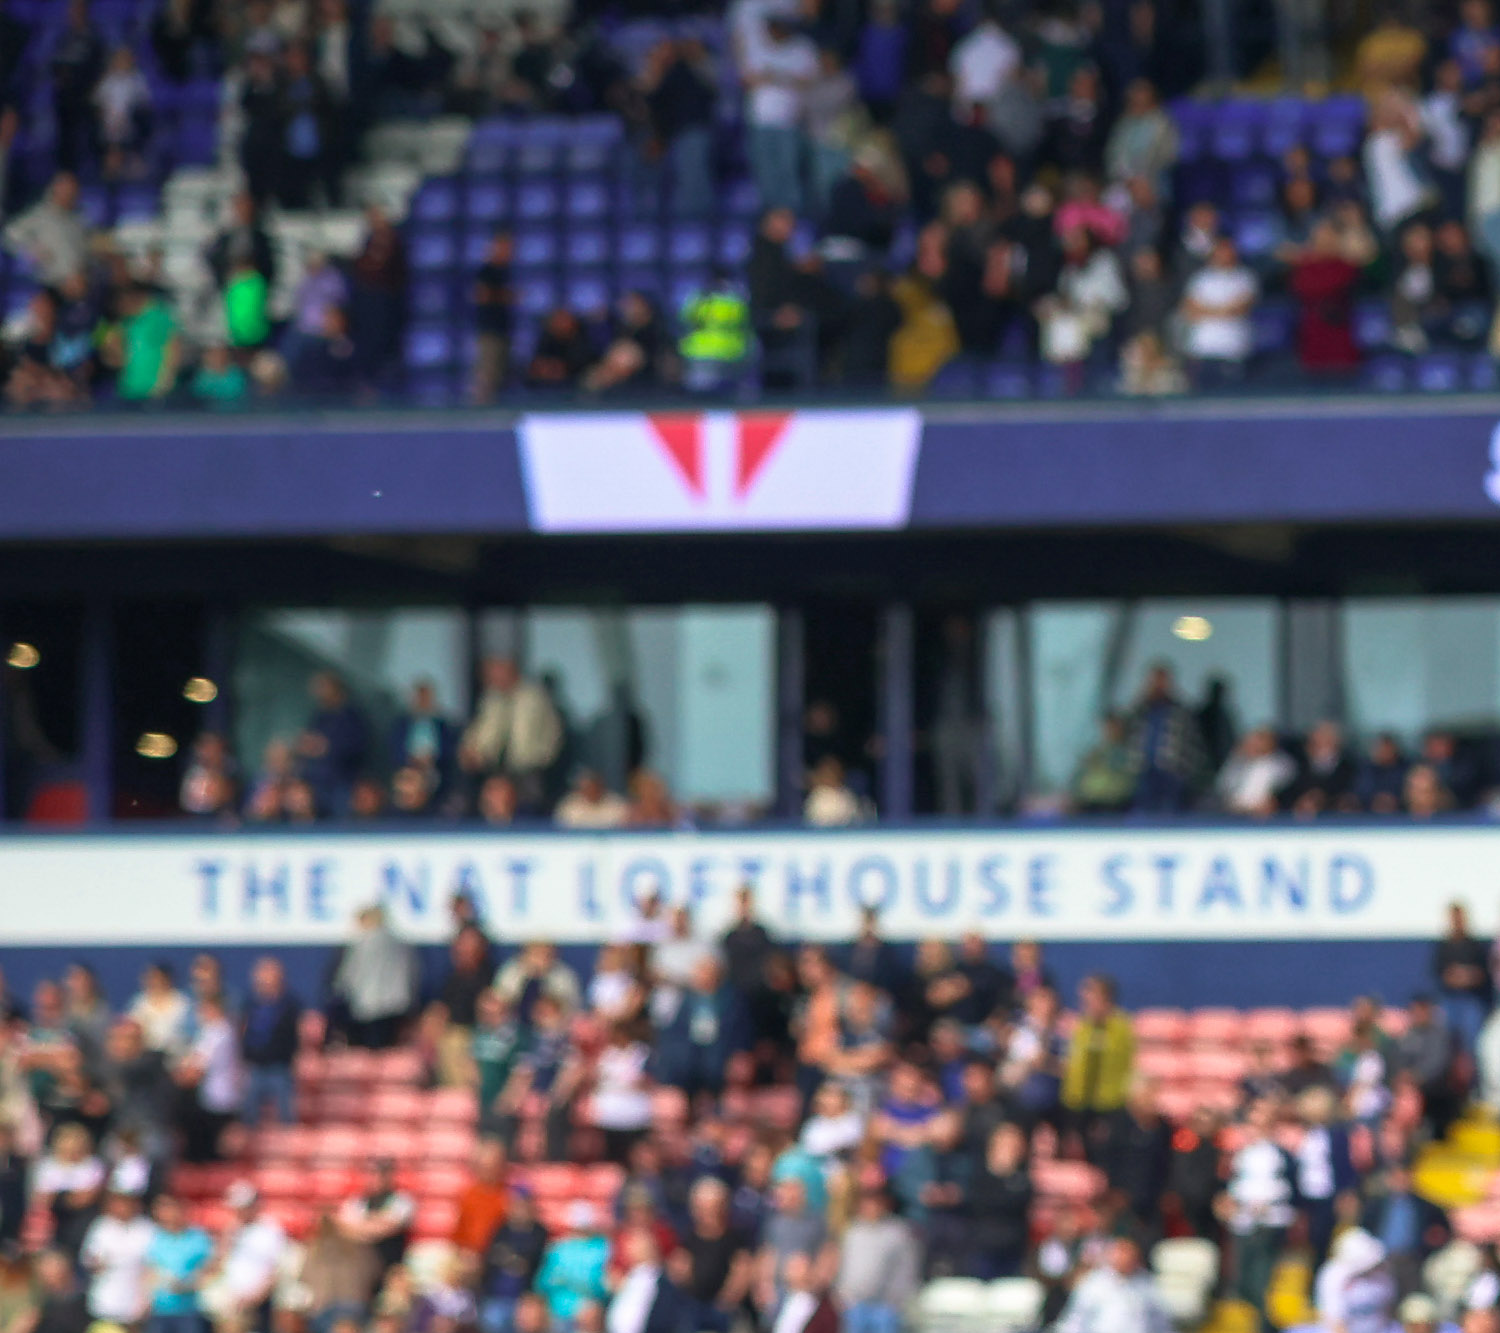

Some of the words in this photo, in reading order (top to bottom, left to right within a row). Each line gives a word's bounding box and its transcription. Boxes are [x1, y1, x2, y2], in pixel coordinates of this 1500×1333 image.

[193, 856, 340, 920] THE
[378, 856, 543, 918] NAT
[1100, 852, 1377, 917] STAND
